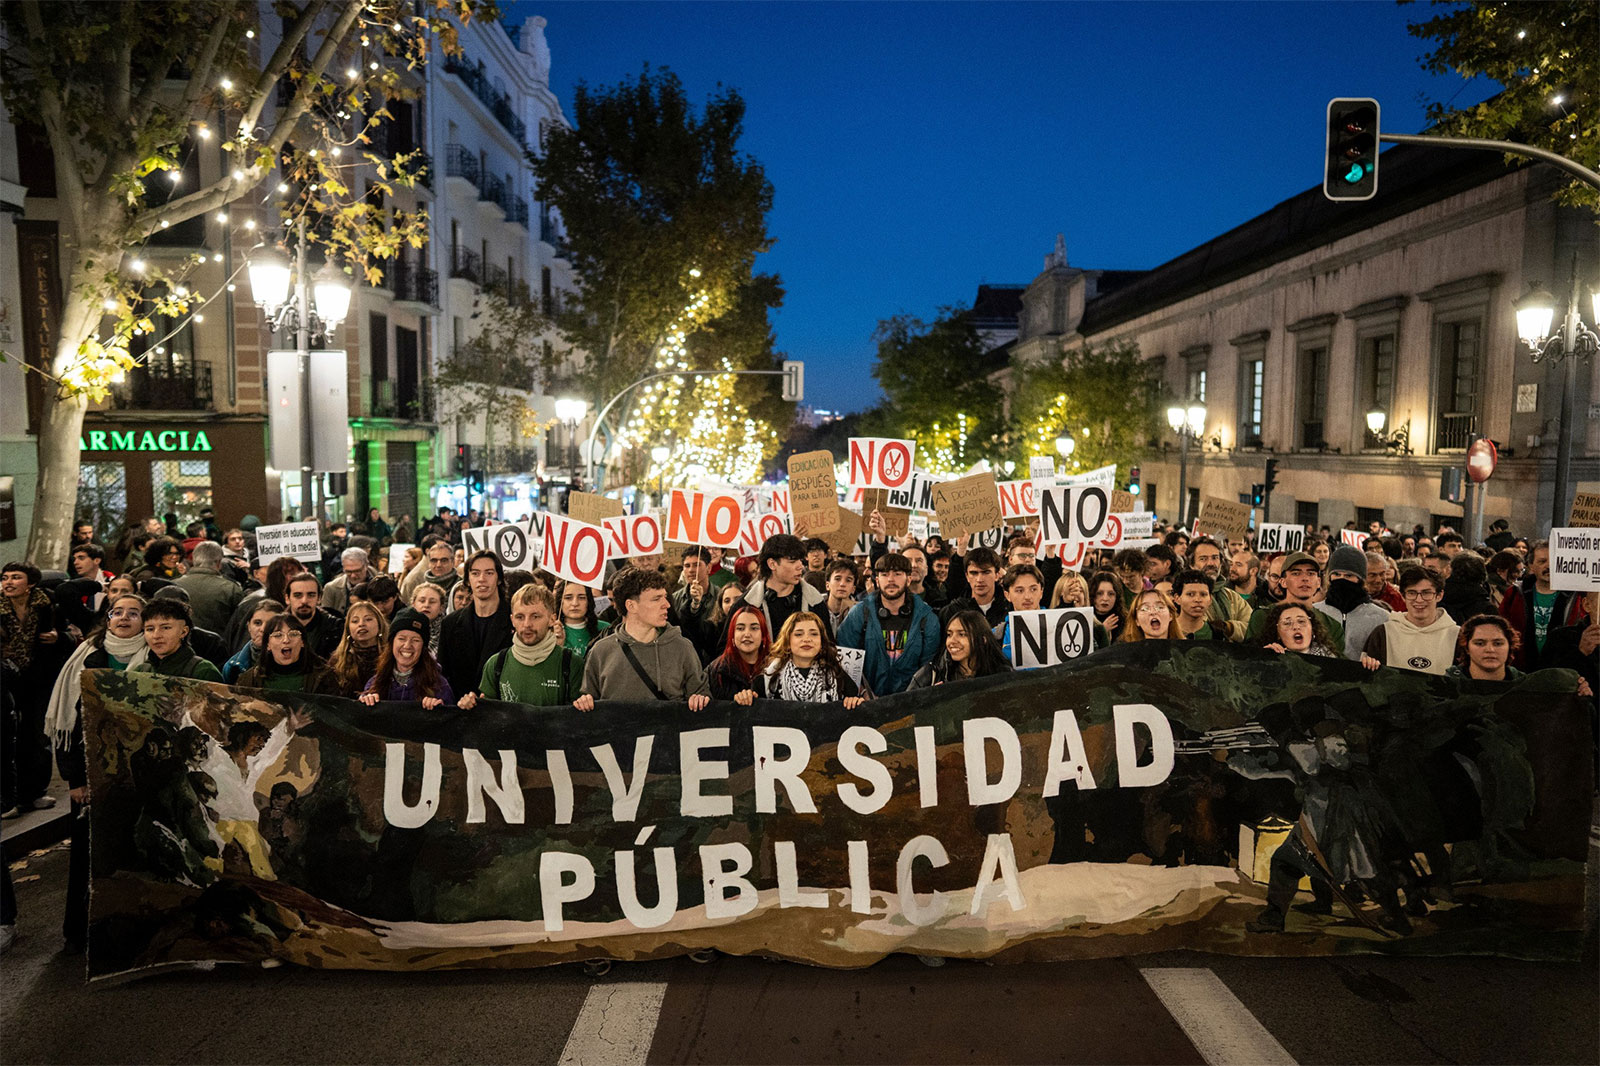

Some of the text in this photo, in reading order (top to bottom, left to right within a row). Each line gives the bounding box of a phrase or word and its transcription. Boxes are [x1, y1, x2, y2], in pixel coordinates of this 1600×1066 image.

[791, 473, 832, 491] DESPUÉS
[850, 441, 910, 487] NO
[793, 493, 811, 502] PARA
[935, 489, 947, 505] A
[1042, 487, 1108, 541] NO
[258, 529, 281, 541] Inversión
[603, 516, 659, 556] NO
[668, 490, 741, 545] NO
[259, 543, 283, 556] Madrid,
[284, 543, 290, 553] ni
[291, 543, 297, 553] la
[465, 525, 527, 568] NO
[543, 515, 604, 582] NO
[1260, 525, 1302, 551] ASÍ, NO
[1557, 532, 1591, 550] Inversión
[1555, 556, 1590, 577] Madrid,
[1013, 611, 1091, 667] NO
[383, 704, 1175, 829] UNIVERSIDAD
[539, 825, 1026, 932] PÚBLICA
